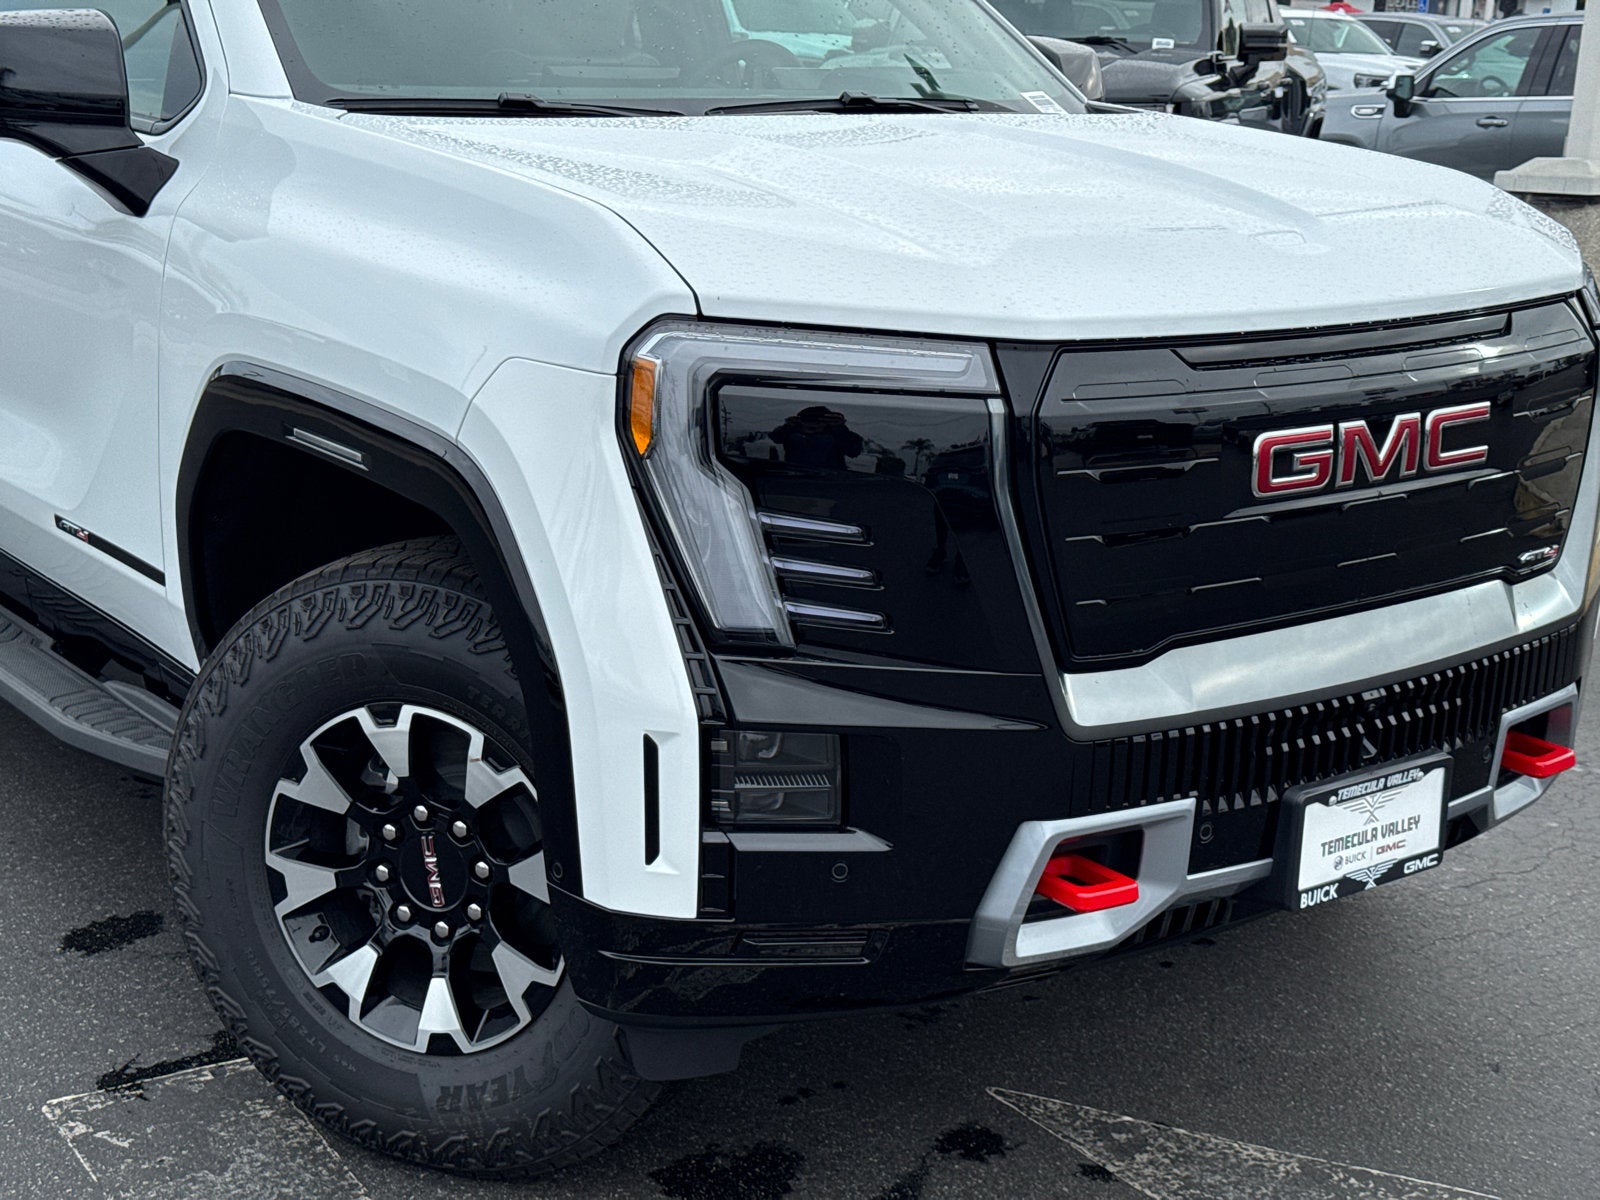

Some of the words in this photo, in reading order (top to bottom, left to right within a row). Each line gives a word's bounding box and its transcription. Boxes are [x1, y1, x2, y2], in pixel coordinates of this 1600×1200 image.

[1252, 401, 1491, 498] GMC
[1337, 777, 1385, 801] TEMECULA
[1387, 768, 1421, 787] VALLEY
[1321, 827, 1378, 857] TEMECULA
[1381, 815, 1421, 838] VALLEY
[1345, 851, 1366, 865] BUICK
[1376, 839, 1406, 856] GMC
[421, 836, 445, 907] GMC
[1403, 853, 1439, 874] GMC
[1300, 883, 1339, 909] BUICK
